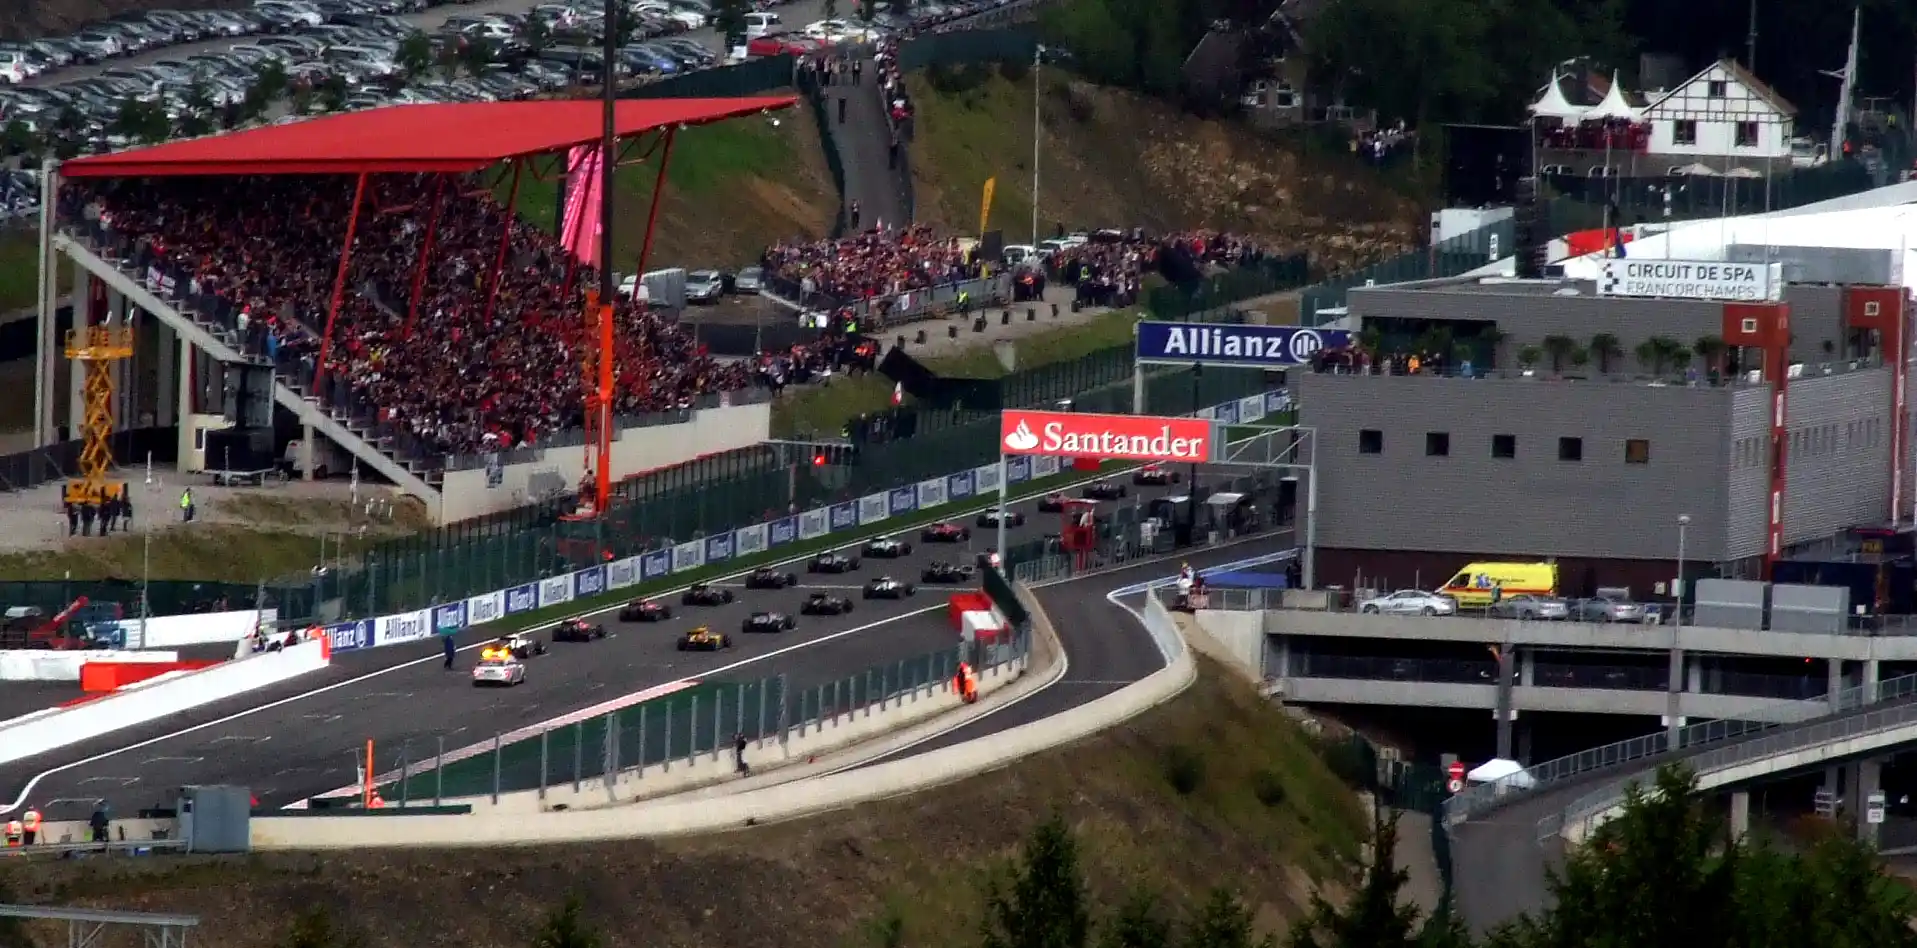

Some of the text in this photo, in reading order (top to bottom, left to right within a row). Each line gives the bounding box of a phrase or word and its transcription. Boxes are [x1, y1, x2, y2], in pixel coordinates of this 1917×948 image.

[1627, 263, 1756, 282] CIRCUIT DE SPA
[1163, 326, 1283, 358] Allianz
[1043, 421, 1206, 459] Santander
[328, 626, 355, 648] llianz
[384, 616, 417, 641] Allianz
